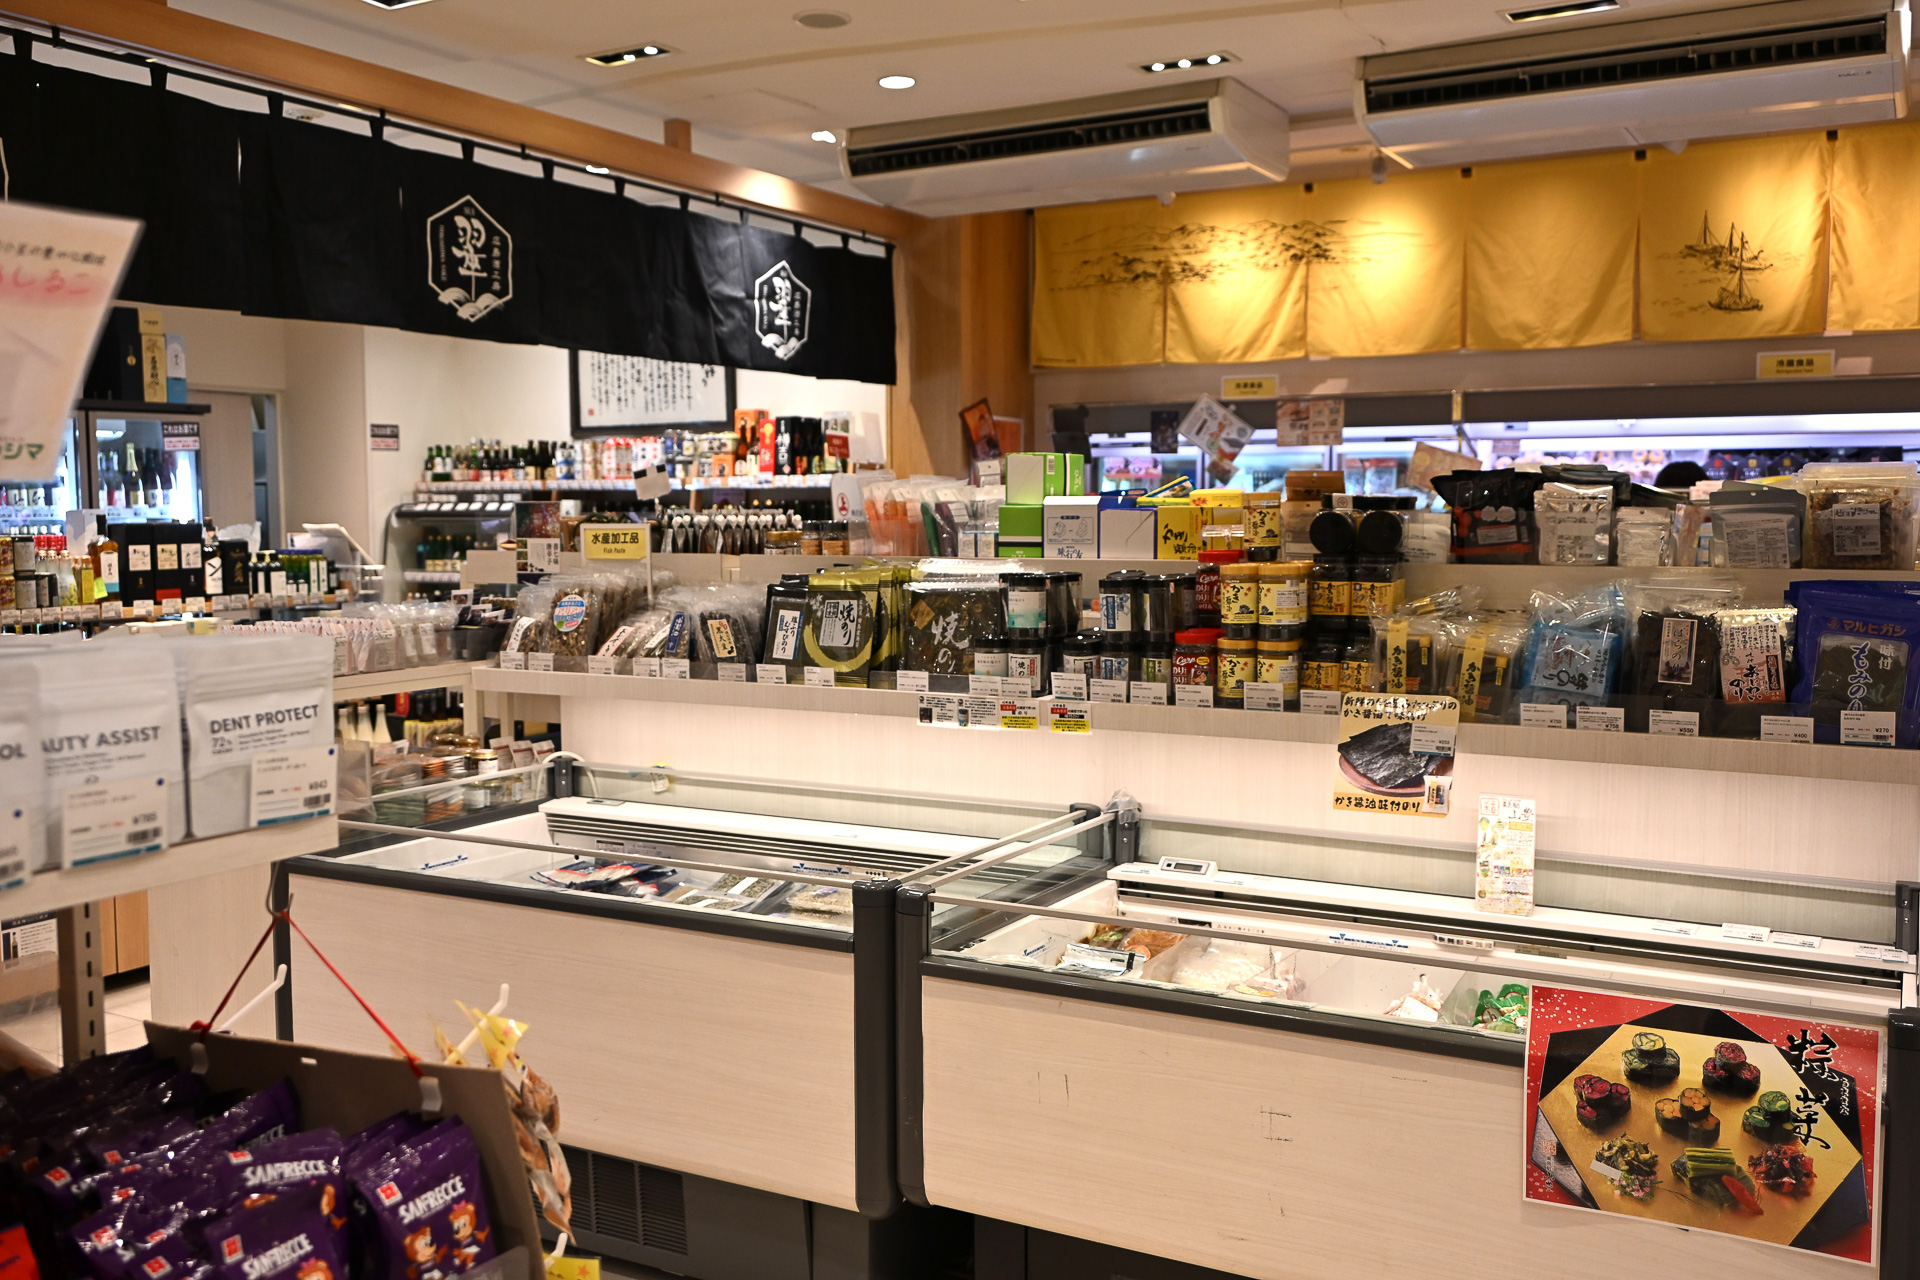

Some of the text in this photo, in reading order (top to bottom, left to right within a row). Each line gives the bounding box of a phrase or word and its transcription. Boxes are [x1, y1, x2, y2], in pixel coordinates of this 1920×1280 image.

[592, 532, 639, 544] 水産加工品
[840, 601, 856, 645] 焼のり
[1843, 619, 1907, 637] マルヒガシ
[1176, 656, 1196, 665] Carp
[1392, 645, 1406, 689] かき醤油
[1878, 644, 1895, 670] 味付
[1463, 661, 1481, 706] かき醤油
[210, 704, 320, 735] DENT PROTECT
[96, 726, 161, 747] ASSIST
[1335, 796, 1421, 813] かき醤油味付のり
[244, 1159, 328, 1188] SANFRECCE
[398, 1175, 466, 1226] SANFRECCE
[242, 1232, 314, 1280] SANFRECCE
